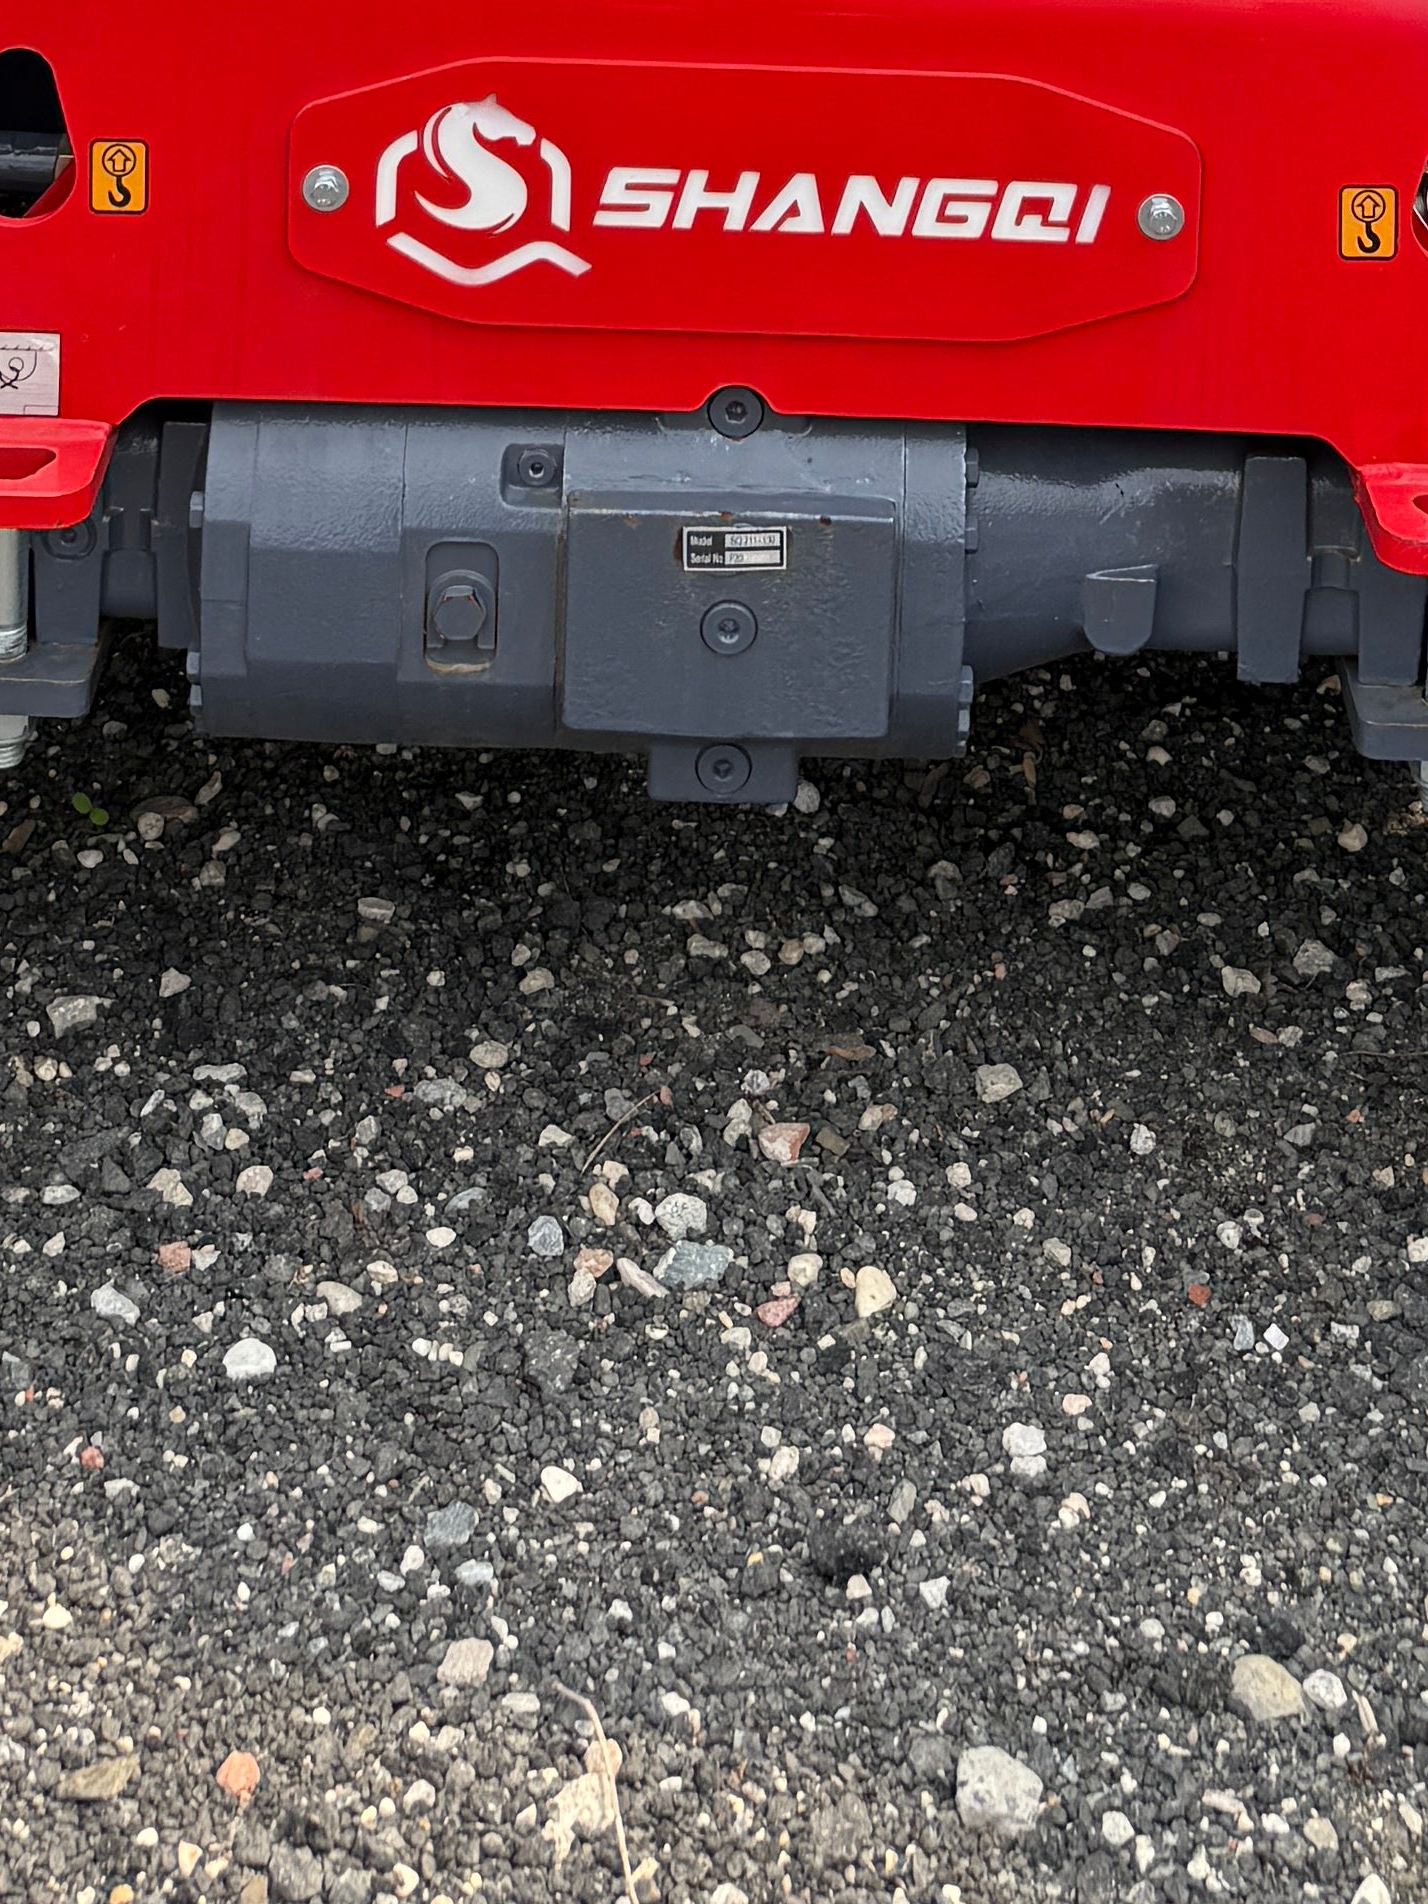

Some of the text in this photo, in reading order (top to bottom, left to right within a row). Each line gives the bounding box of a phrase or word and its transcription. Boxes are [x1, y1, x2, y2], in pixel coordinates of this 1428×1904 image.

[592, 166, 1112, 244] SHANGQI
[690, 535, 713, 546] Model
[690, 552, 711, 564] Serial
